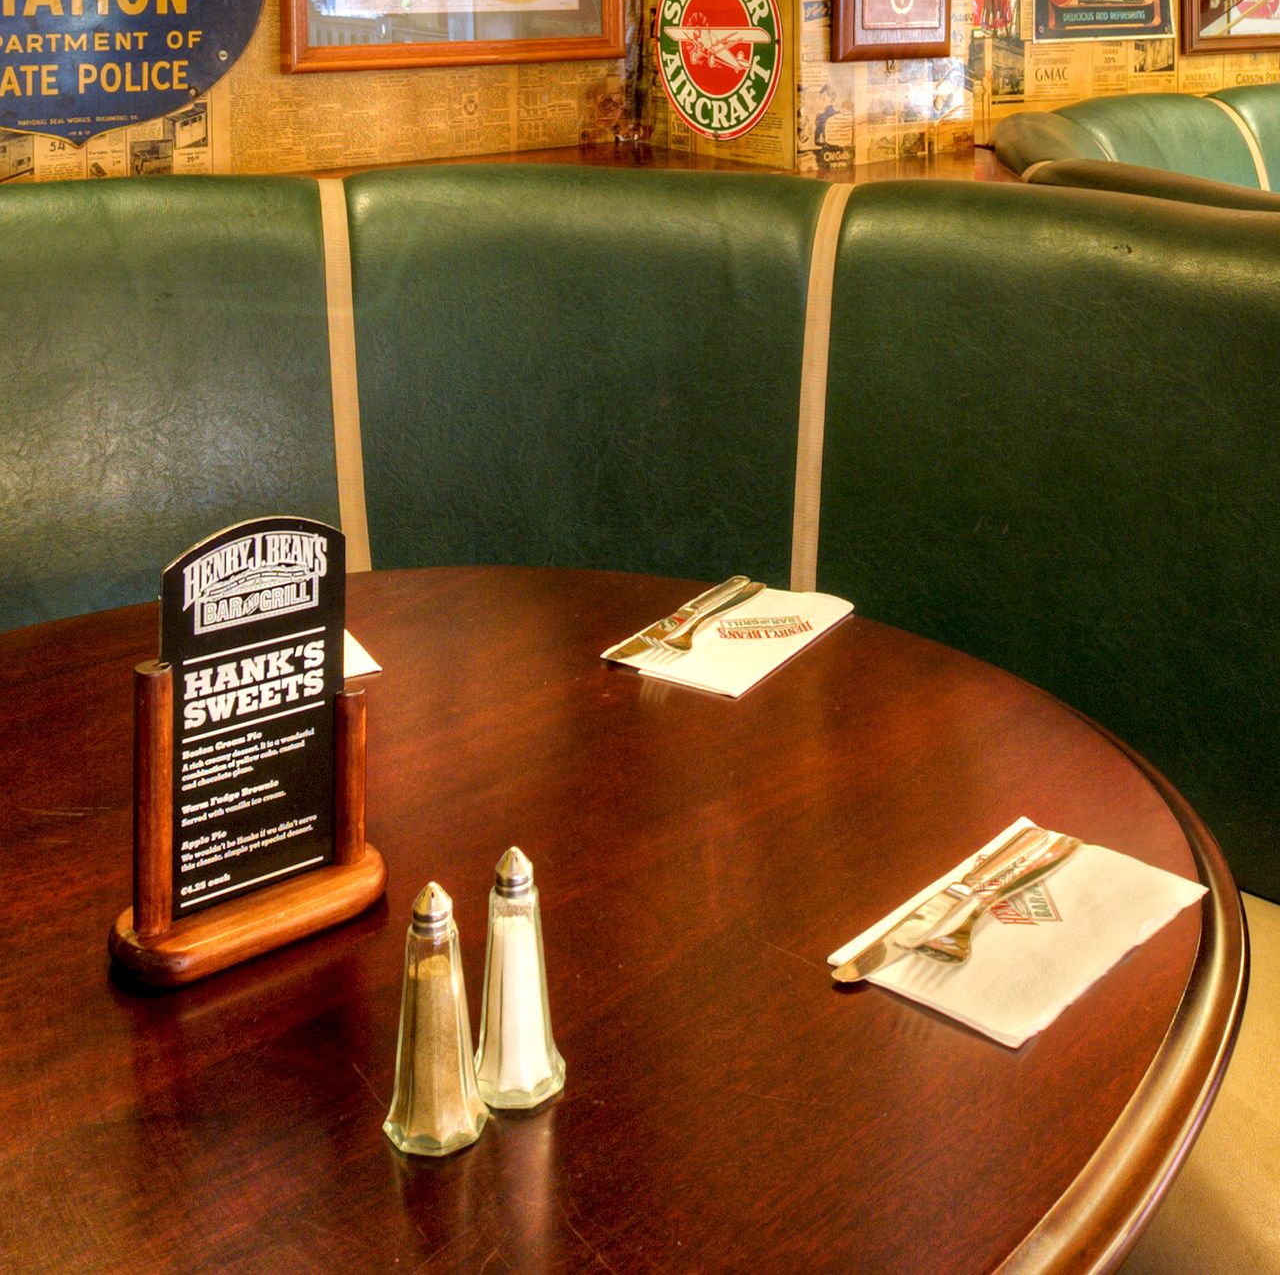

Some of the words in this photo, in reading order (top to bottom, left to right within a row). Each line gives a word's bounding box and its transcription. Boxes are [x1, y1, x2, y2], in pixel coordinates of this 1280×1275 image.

[1063, 11, 1094, 23] DELICIOUS
[1096, 11, 1109, 21] AND
[1110, 9, 1145, 21] REFRESHING
[167, 30, 204, 50] OF
[78, 60, 190, 95] POLICE
[1034, 67, 1069, 81] GMAC
[1235, 72, 1263, 84] CARSON
[662, 51, 772, 128] AIRCRAFT
[182, 540, 253, 612] HENRY
[248, 533, 266, 570] J.
[265, 532, 328, 577] BEAN'S
[202, 596, 243, 625] BAR
[260, 580, 312, 612] GRILL
[183, 639, 325, 701] HANK'S
[183, 667, 325, 730] SWEETS
[215, 738, 246, 752] Cream
[246, 731, 263, 743] Pie
[181, 800, 210, 815] Warm
[210, 790, 241, 808] Fudge
[241, 778, 280, 798] Brownie
[181, 813, 207, 828] Served
[181, 835, 210, 852] Apple
[211, 829, 228, 842] Pie
